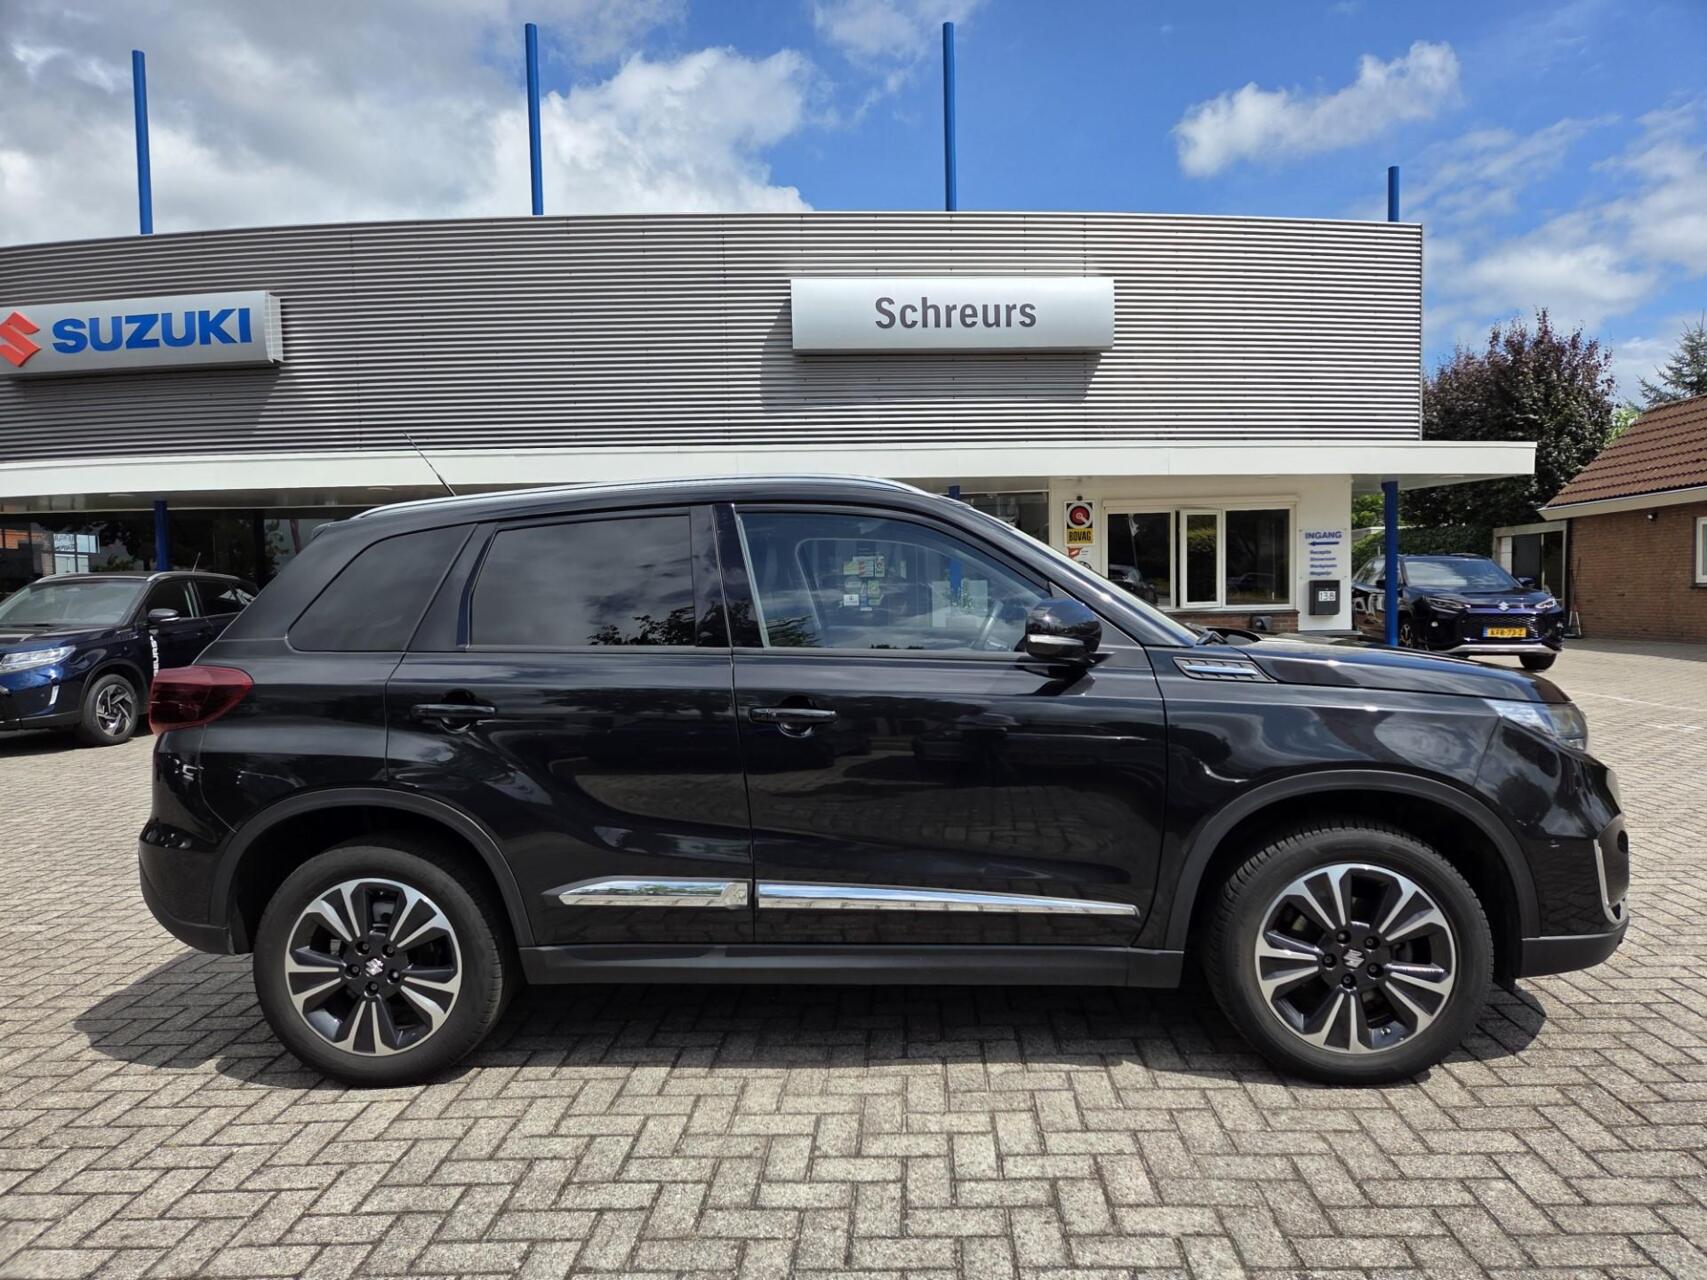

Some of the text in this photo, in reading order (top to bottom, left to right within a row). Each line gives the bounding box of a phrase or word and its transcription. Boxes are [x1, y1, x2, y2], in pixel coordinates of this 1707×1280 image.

[874, 296, 1037, 329] Schreurs
[52, 307, 252, 354] SUZUKI
[1068, 531, 1092, 542] BOVAG
[1305, 531, 1343, 539] INGANG
